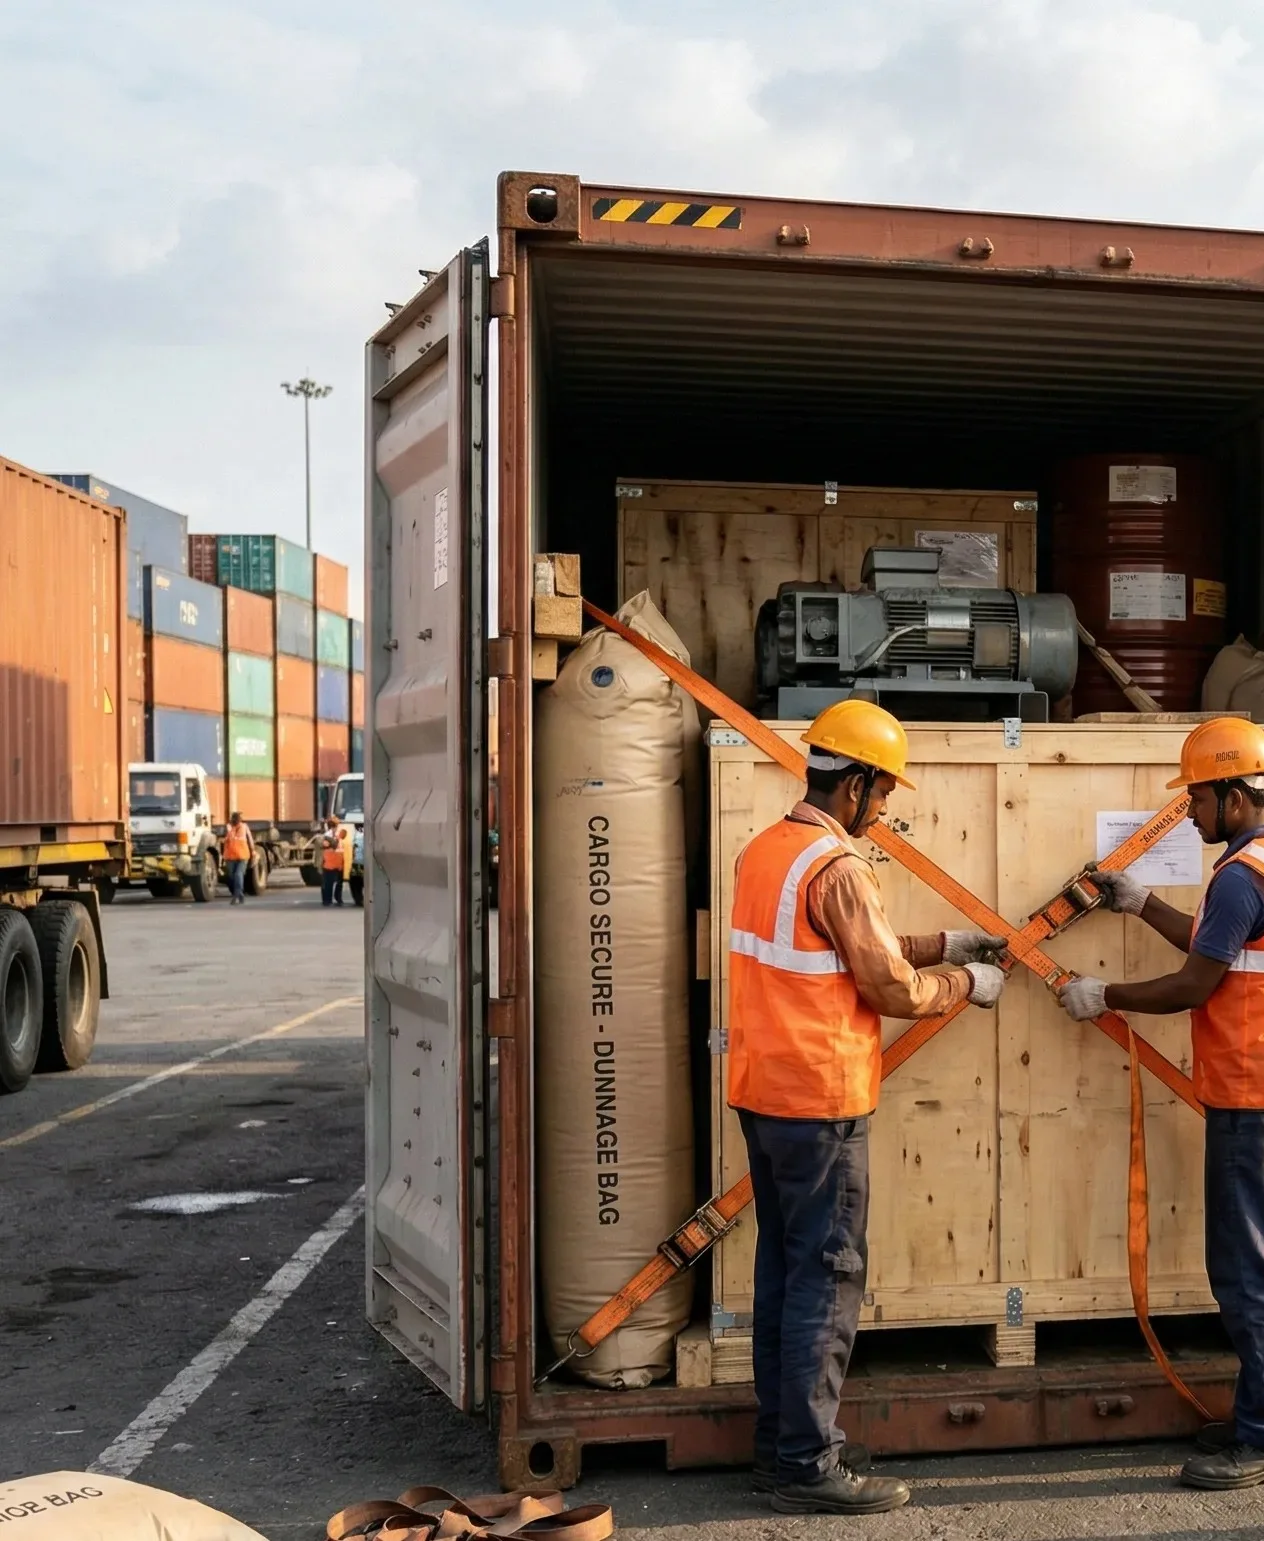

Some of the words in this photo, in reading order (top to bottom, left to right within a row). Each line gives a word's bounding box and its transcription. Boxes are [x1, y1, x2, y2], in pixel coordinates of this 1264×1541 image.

[588, 815, 611, 906] CARGO
[590, 914, 613, 1016] SECURE
[593, 1041, 618, 1164] DUNNAGE
[597, 1173, 620, 1225] BAG
